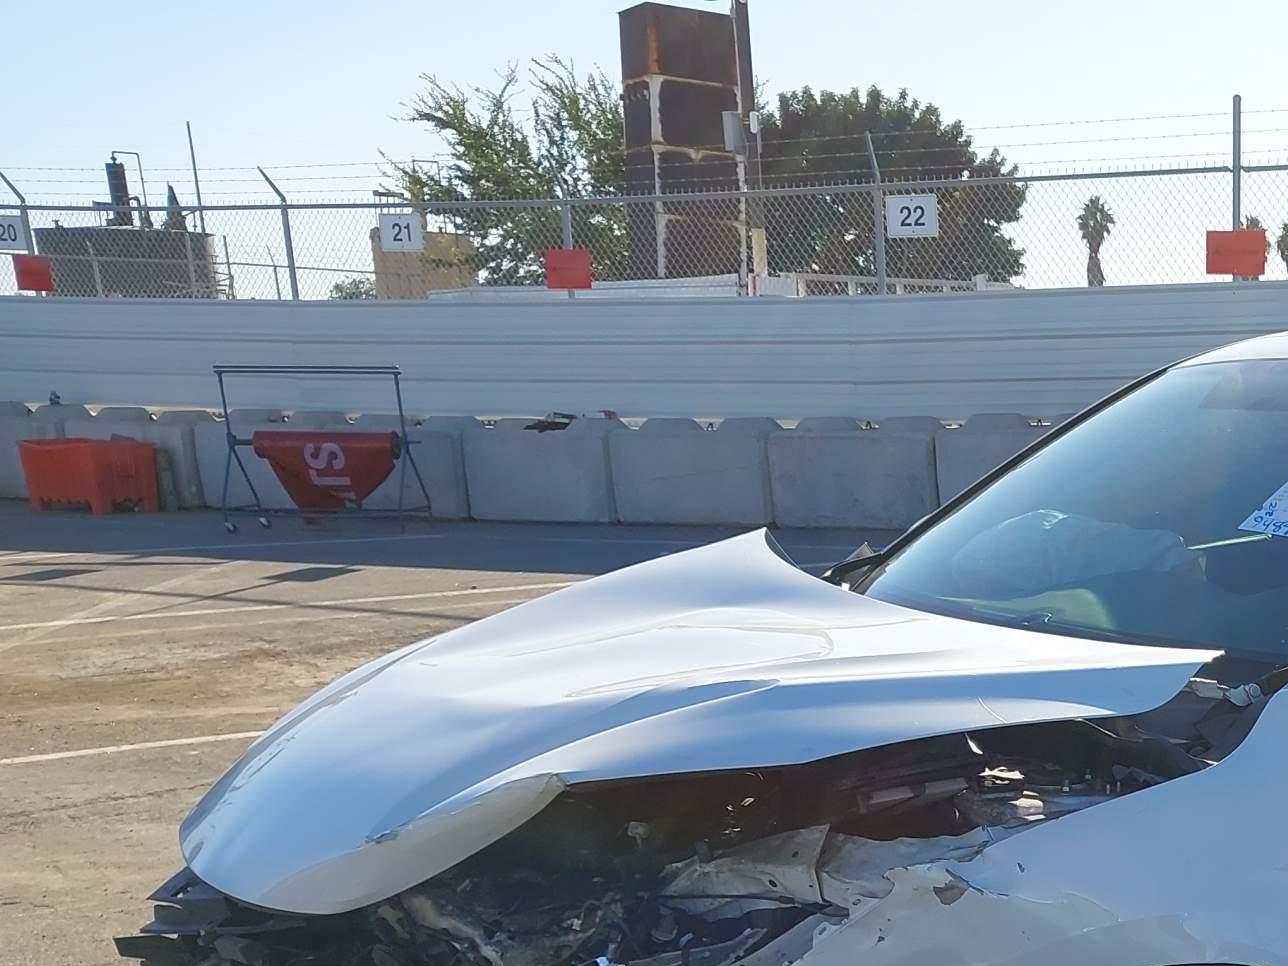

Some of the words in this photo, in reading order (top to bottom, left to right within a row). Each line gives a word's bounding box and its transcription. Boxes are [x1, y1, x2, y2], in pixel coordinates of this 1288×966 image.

[899, 205, 926, 227] 22
[0, 223, 17, 242] 20
[391, 222, 412, 243] 21
